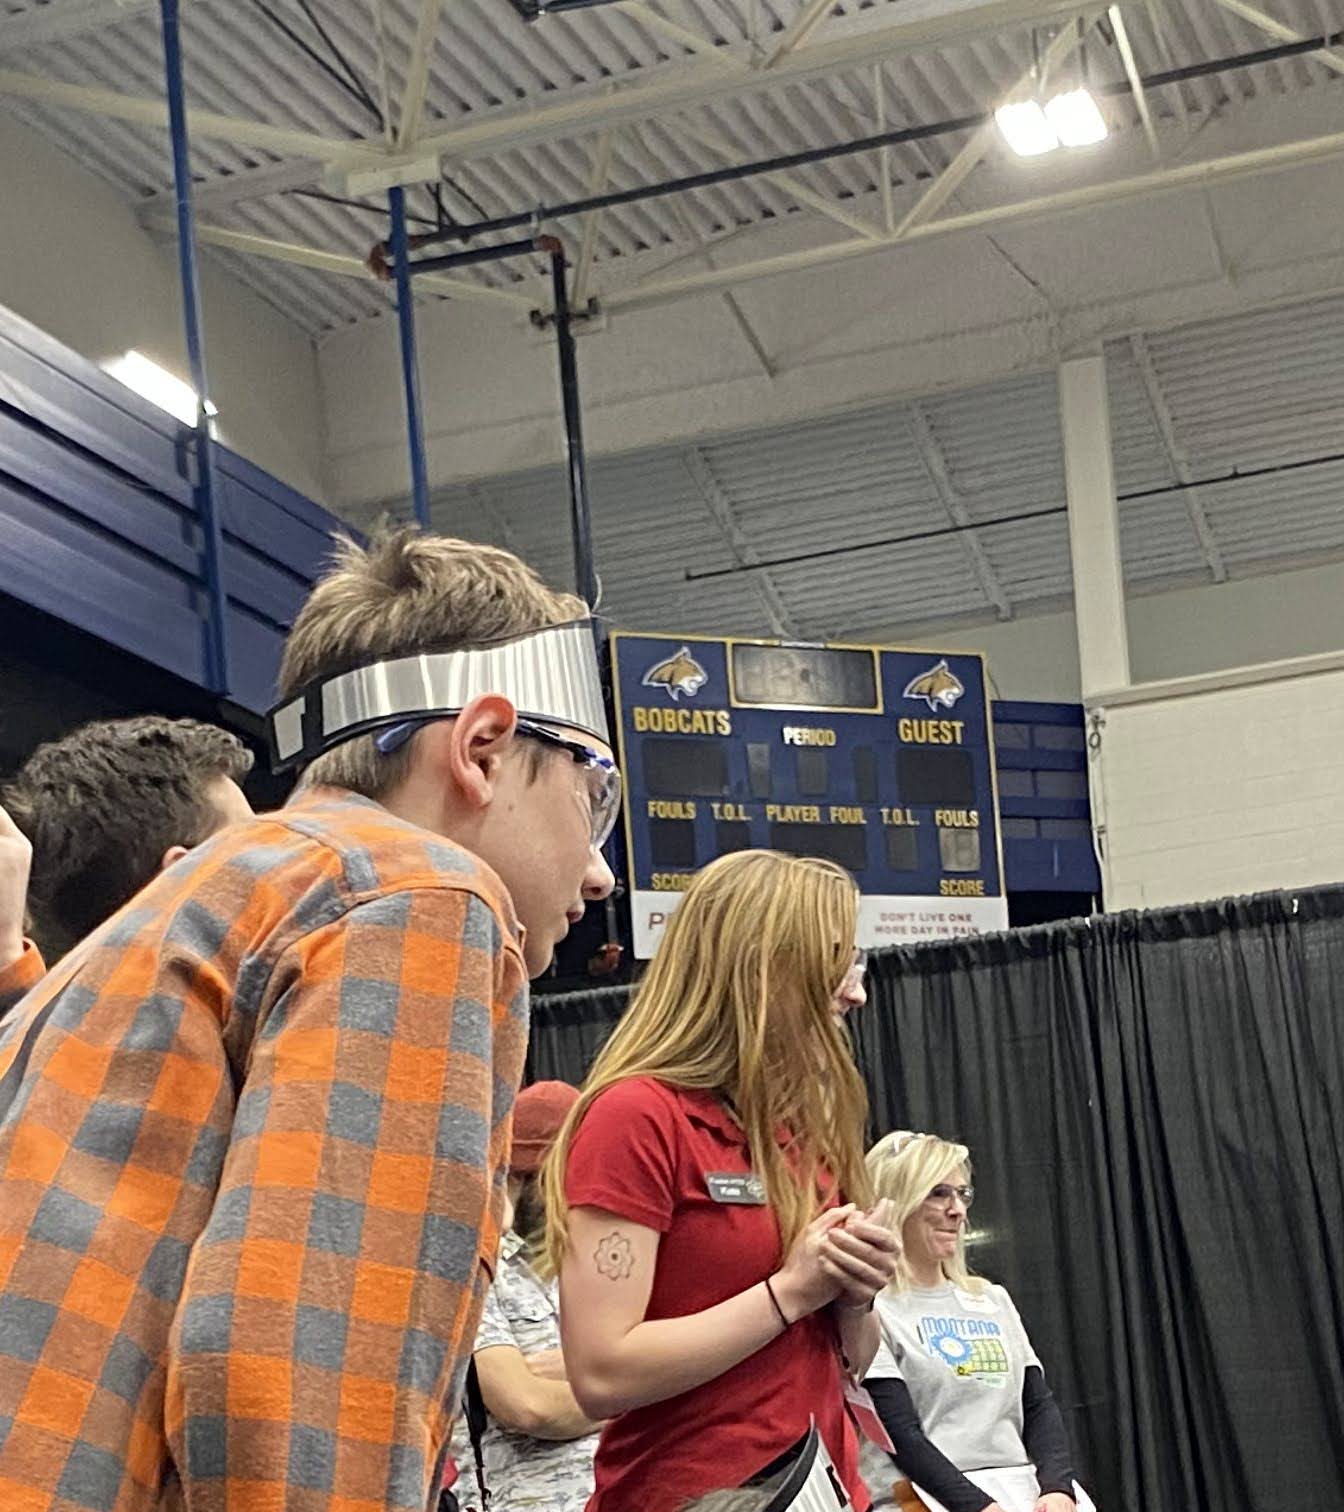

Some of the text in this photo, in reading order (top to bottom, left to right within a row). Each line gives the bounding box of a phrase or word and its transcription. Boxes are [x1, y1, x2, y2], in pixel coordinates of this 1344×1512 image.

[633, 706, 732, 737] BOBCATS
[783, 726, 836, 747] PERIOD
[898, 719, 965, 745] GUEST
[647, 801, 696, 820] FOULS
[766, 805, 867, 825] PLAYER FOUL
[935, 809, 979, 828] FOULS
[940, 878, 985, 897] SCORE
[948, 912, 972, 922] ONE
[911, 926, 933, 935] DAY
[921, 1315, 1001, 1337] MONTANA
